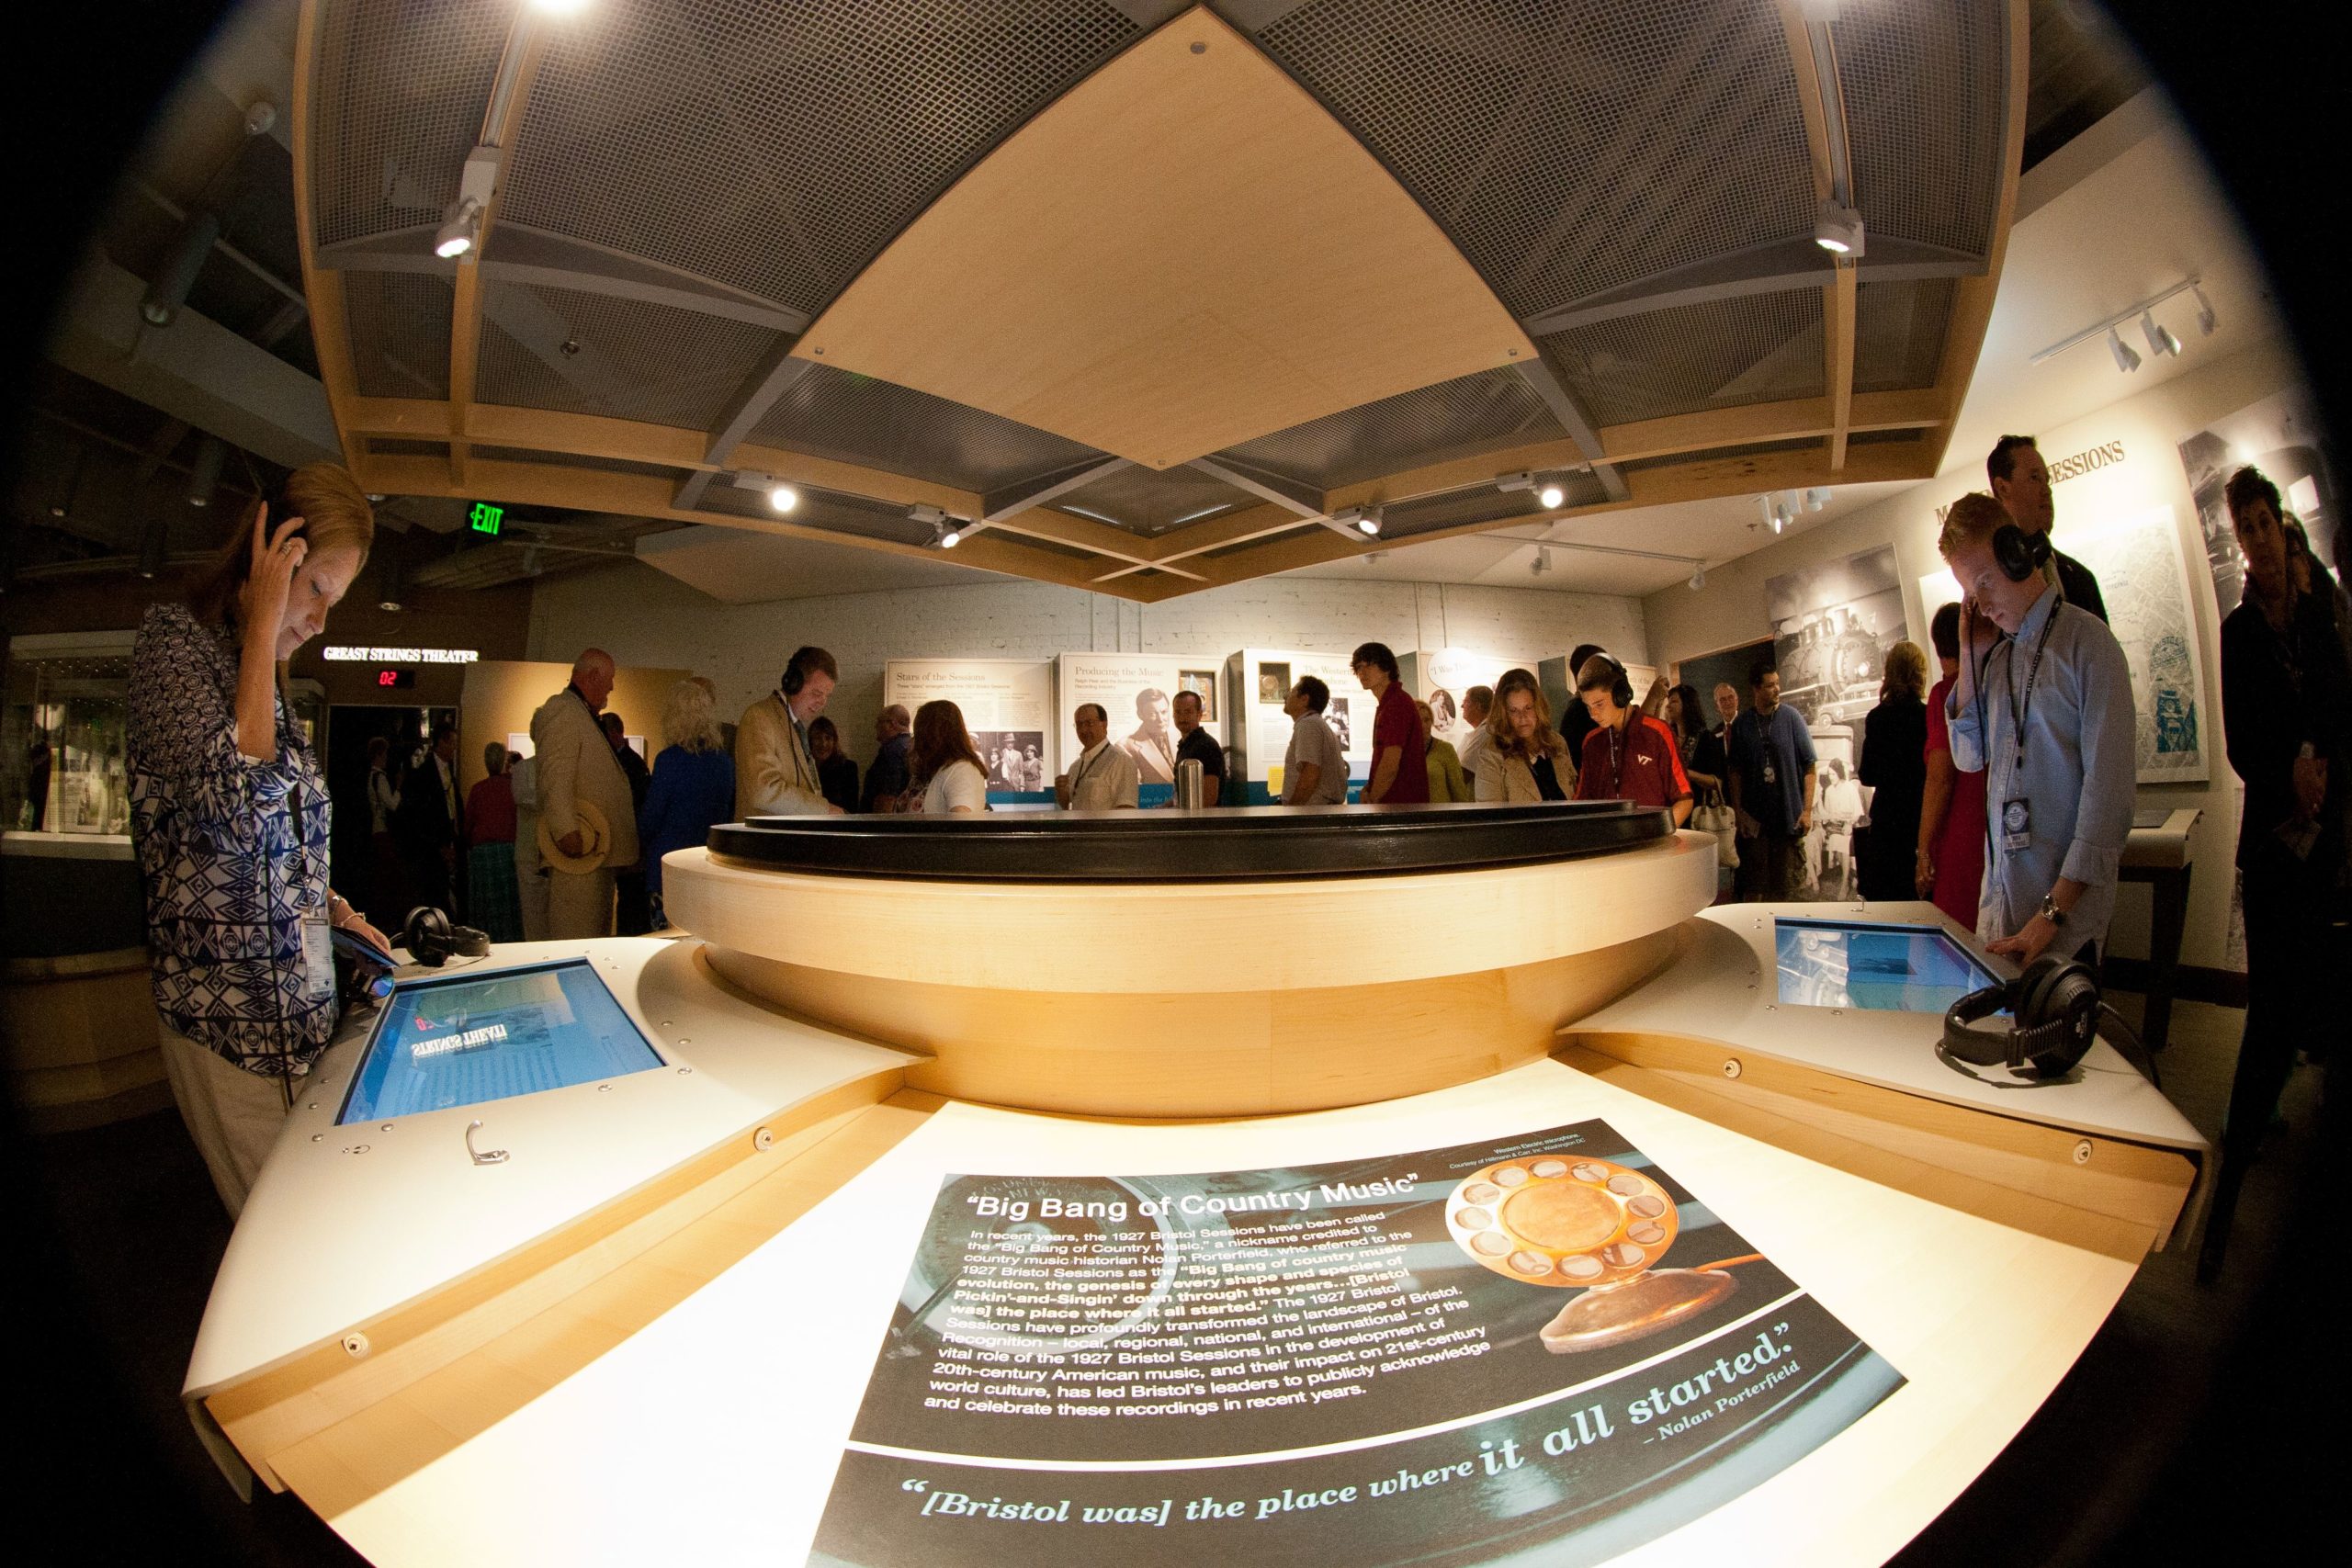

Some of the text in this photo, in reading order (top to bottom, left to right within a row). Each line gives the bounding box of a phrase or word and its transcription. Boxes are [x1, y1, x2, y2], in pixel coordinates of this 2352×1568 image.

[472, 502, 504, 535] EXIT
[369, 648, 421, 662] STRINGS
[421, 649, 480, 664] THEATER
[1074, 666, 1164, 677] Producing the Music
[379, 671, 398, 685] 02
[897, 671, 986, 682] Stars of the Sessions
[1637, 754, 1653, 766] VT
[1449, 1160, 1477, 1169] Courtesy
[1544, 1141, 1577, 1152] Washington
[1493, 1145, 1521, 1155] Western
[967, 1173, 1419, 1223] “Big Bang of Country Music”
[967, 1241, 990, 1251] the
[1030, 1243, 1068, 1255] Bang
[1072, 1244, 1087, 1253] of
[1091, 1243, 1149, 1254] Country
[1215, 1240, 1222, 1248] a
[1227, 1235, 1297, 1247] nickname
[1301, 1225, 1360, 1241] credited
[1362, 1224, 1377, 1235] to
[970, 1212, 1385, 1243] In recent years, the 1927 Bristol Sessions have been called
[963, 1264, 996, 1276] 1927
[1001, 1266, 1049, 1277] Bristol
[1053, 1268, 1123, 1278] Sessions
[1128, 1269, 1147, 1277] as
[1150, 1266, 1175, 1277] the
[1222, 1262, 1266, 1273] Bang
[1271, 1258, 1288, 1269] of
[1291, 1252, 1354, 1267] country
[1360, 1244, 1407, 1258] music
[964, 1230, 1412, 1267] country music historian Nolan Porterfield, who referred to the
[956, 1256, 1402, 1293] evolution, the genesis of every shape and species of
[945, 1285, 1463, 1335] Sessions have profoundly transformed the landscape of Bristol.
[950, 1305, 990, 1318] was]
[995, 1306, 1024, 1317] the
[1029, 1307, 1079, 1320] place
[1084, 1308, 1142, 1318] where
[1148, 1306, 1159, 1317] it
[1164, 1305, 1185, 1317] all
[1273, 1296, 1306, 1309] The
[1310, 1290, 1345, 1305] 1927
[1351, 1281, 1400, 1300] Bristol
[954, 1290, 1117, 1306] Pickin’-and-Singin’
[1123, 1293, 1171, 1304] down
[1177, 1288, 1249, 1303] through
[1252, 1286, 1281, 1298] the
[938, 1317, 1446, 1364] vital role of the 1927 Bristol Sessions in the development of
[942, 1299, 1469, 1350] Recognition local, regional, national, and international of the
[929, 1342, 1490, 1399] world culture, has led Bristol’s leaders to publicly acknowledge
[933, 1327, 1486, 1382] 20th-century American music, and their impact on 21st-century
[923, 1385, 1366, 1416] and celebrate these recordings in recent years.
[1657, 1359, 1801, 1441] Nolan Porterfield
[1083, 1499, 1172, 1527] was]
[1184, 1494, 1246, 1520] the
[1254, 1484, 1358, 1520] place
[1368, 1458, 1475, 1498] where
[1477, 1439, 1525, 1477] it
[1543, 1404, 1615, 1457] all
[1627, 1321, 1793, 1427] started.”
